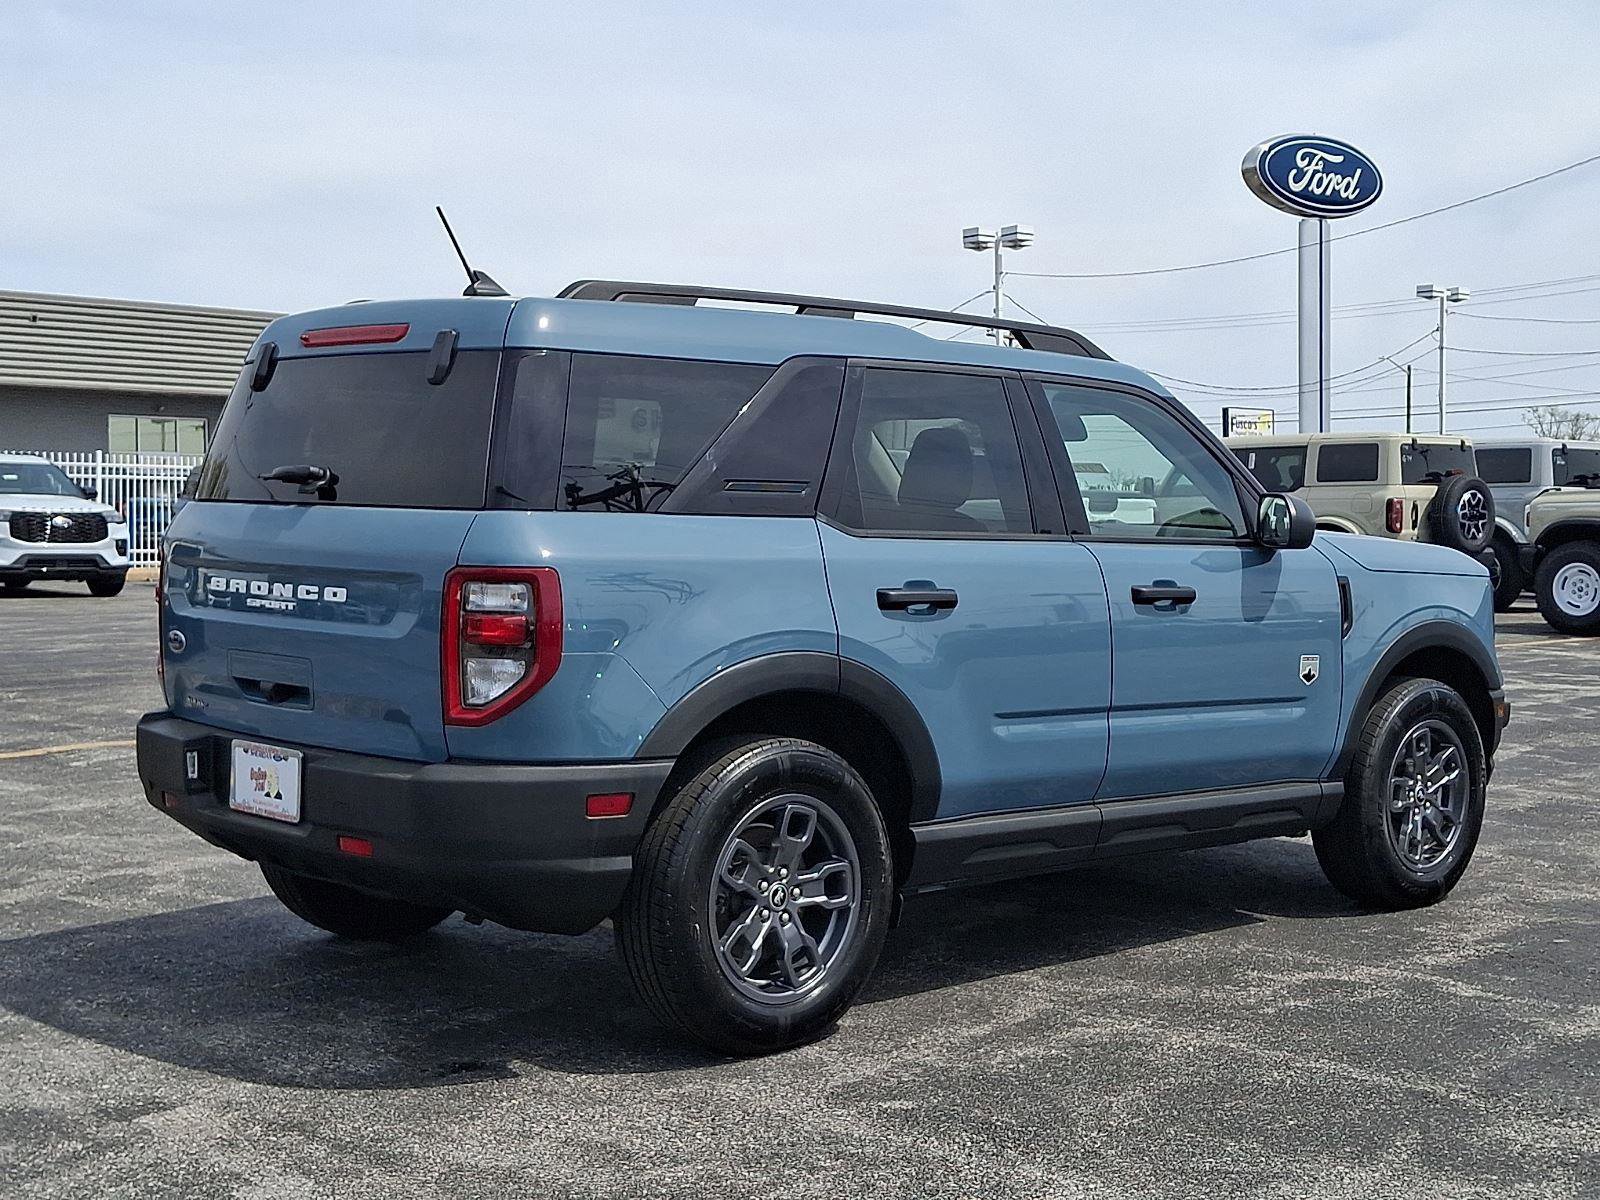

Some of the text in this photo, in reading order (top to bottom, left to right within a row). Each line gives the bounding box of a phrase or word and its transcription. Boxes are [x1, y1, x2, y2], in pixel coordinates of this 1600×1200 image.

[1288, 147, 1362, 200] Ford
[209, 576, 348, 603] BRONCO
[246, 598, 297, 611] SPORT
